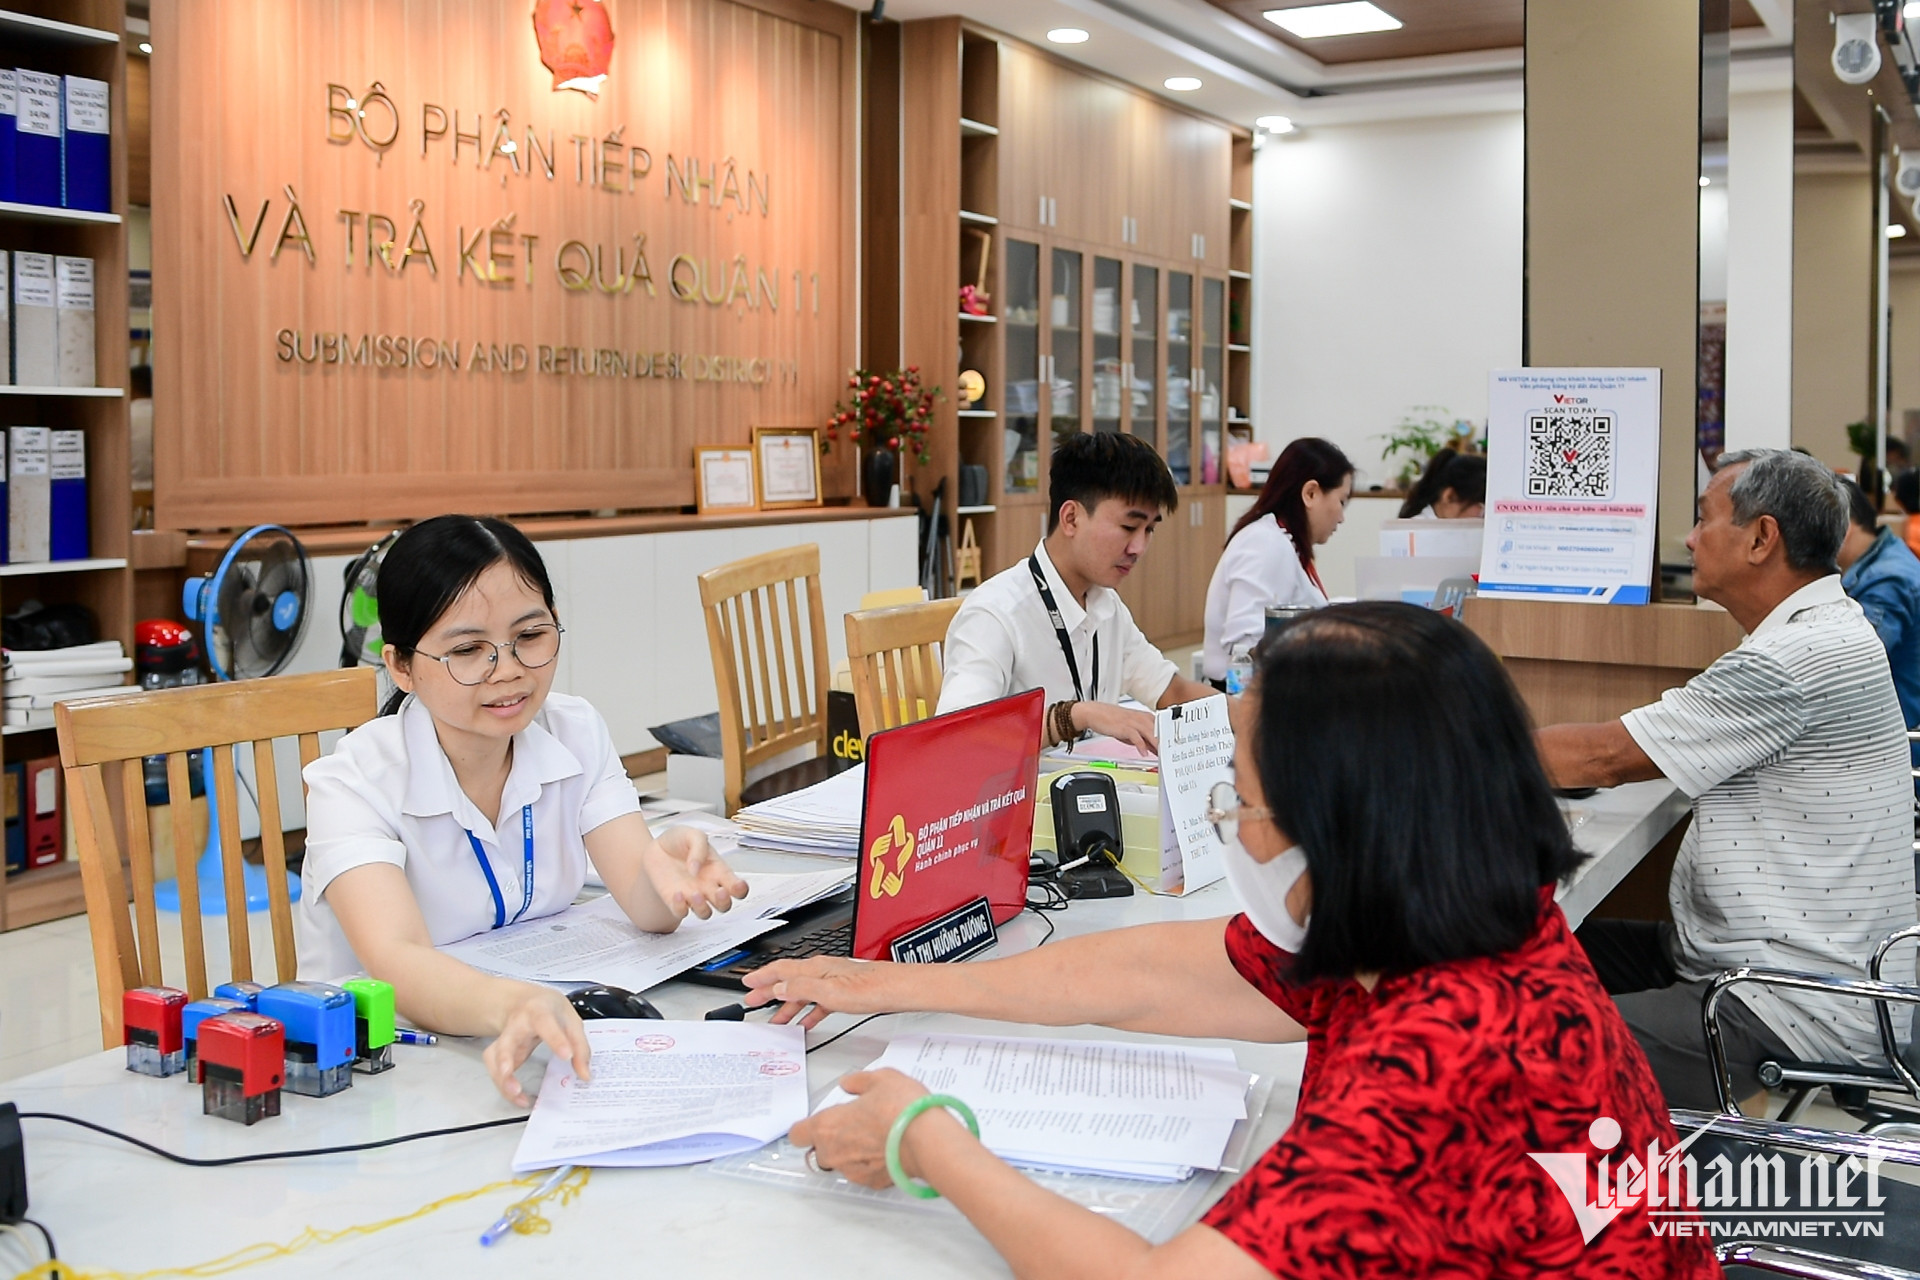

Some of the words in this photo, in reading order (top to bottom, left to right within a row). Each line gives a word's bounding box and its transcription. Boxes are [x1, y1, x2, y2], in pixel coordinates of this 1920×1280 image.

[326, 81, 400, 168] BỘ
[421, 103, 555, 189] PHẬN
[569, 124, 652, 194] TIẾP
[664, 154, 769, 223] NHẬN
[222, 184, 316, 267] VÀ
[337, 199, 437, 276] TRẢ
[456, 212, 539, 286] KẾT
[554, 231, 657, 298] QUẢ
[667, 253, 779, 318] QUẬN
[793, 270, 820, 314] 11
[276, 328, 460, 372] SUBMISSION
[467, 341, 529, 373] AND
[536, 344, 629, 379] RETURN
[633, 350, 688, 381] DESK
[693, 354, 773, 384] DISTRICT
[918, 823, 929, 842] BỘ
[929, 817, 948, 836] PHẬN
[948, 809, 963, 829] TIẾP
[963, 804, 981, 822] NHẬN
[981, 799, 990, 816] VÀ
[990, 793, 1001, 812] TRẢ
[1001, 789, 1014, 808] KẾT
[914, 857, 932, 873] Hành
[933, 848, 952, 865] chính
[953, 842, 969, 858] phục
[970, 838, 979, 849] vụ
[916, 838, 936, 860] QUẬN
[936, 834, 944, 850] 11
[959, 913, 988, 943] DƯƠNG
